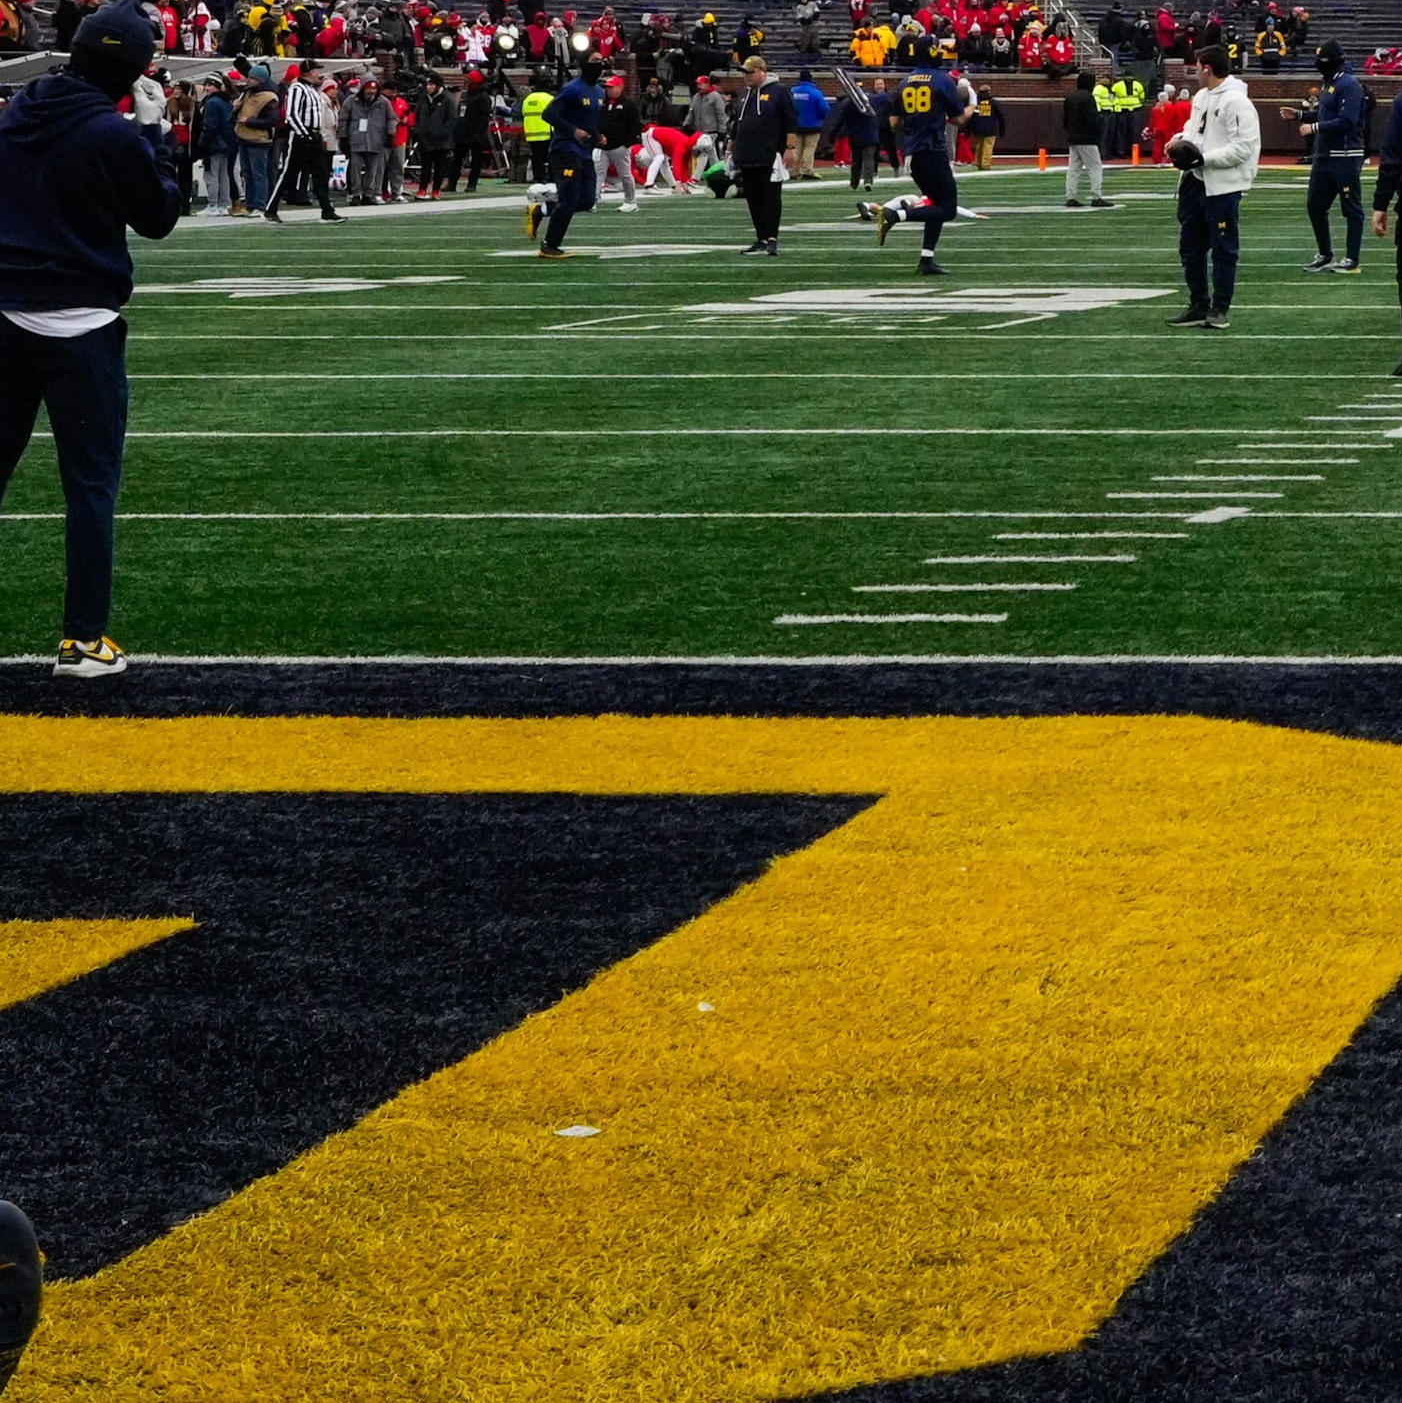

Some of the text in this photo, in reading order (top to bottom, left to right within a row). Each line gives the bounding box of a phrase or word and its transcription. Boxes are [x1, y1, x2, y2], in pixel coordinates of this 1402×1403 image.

[1055, 40, 1064, 53] 4
[1228, 44, 1238, 58] 2
[902, 85, 932, 114] 88
